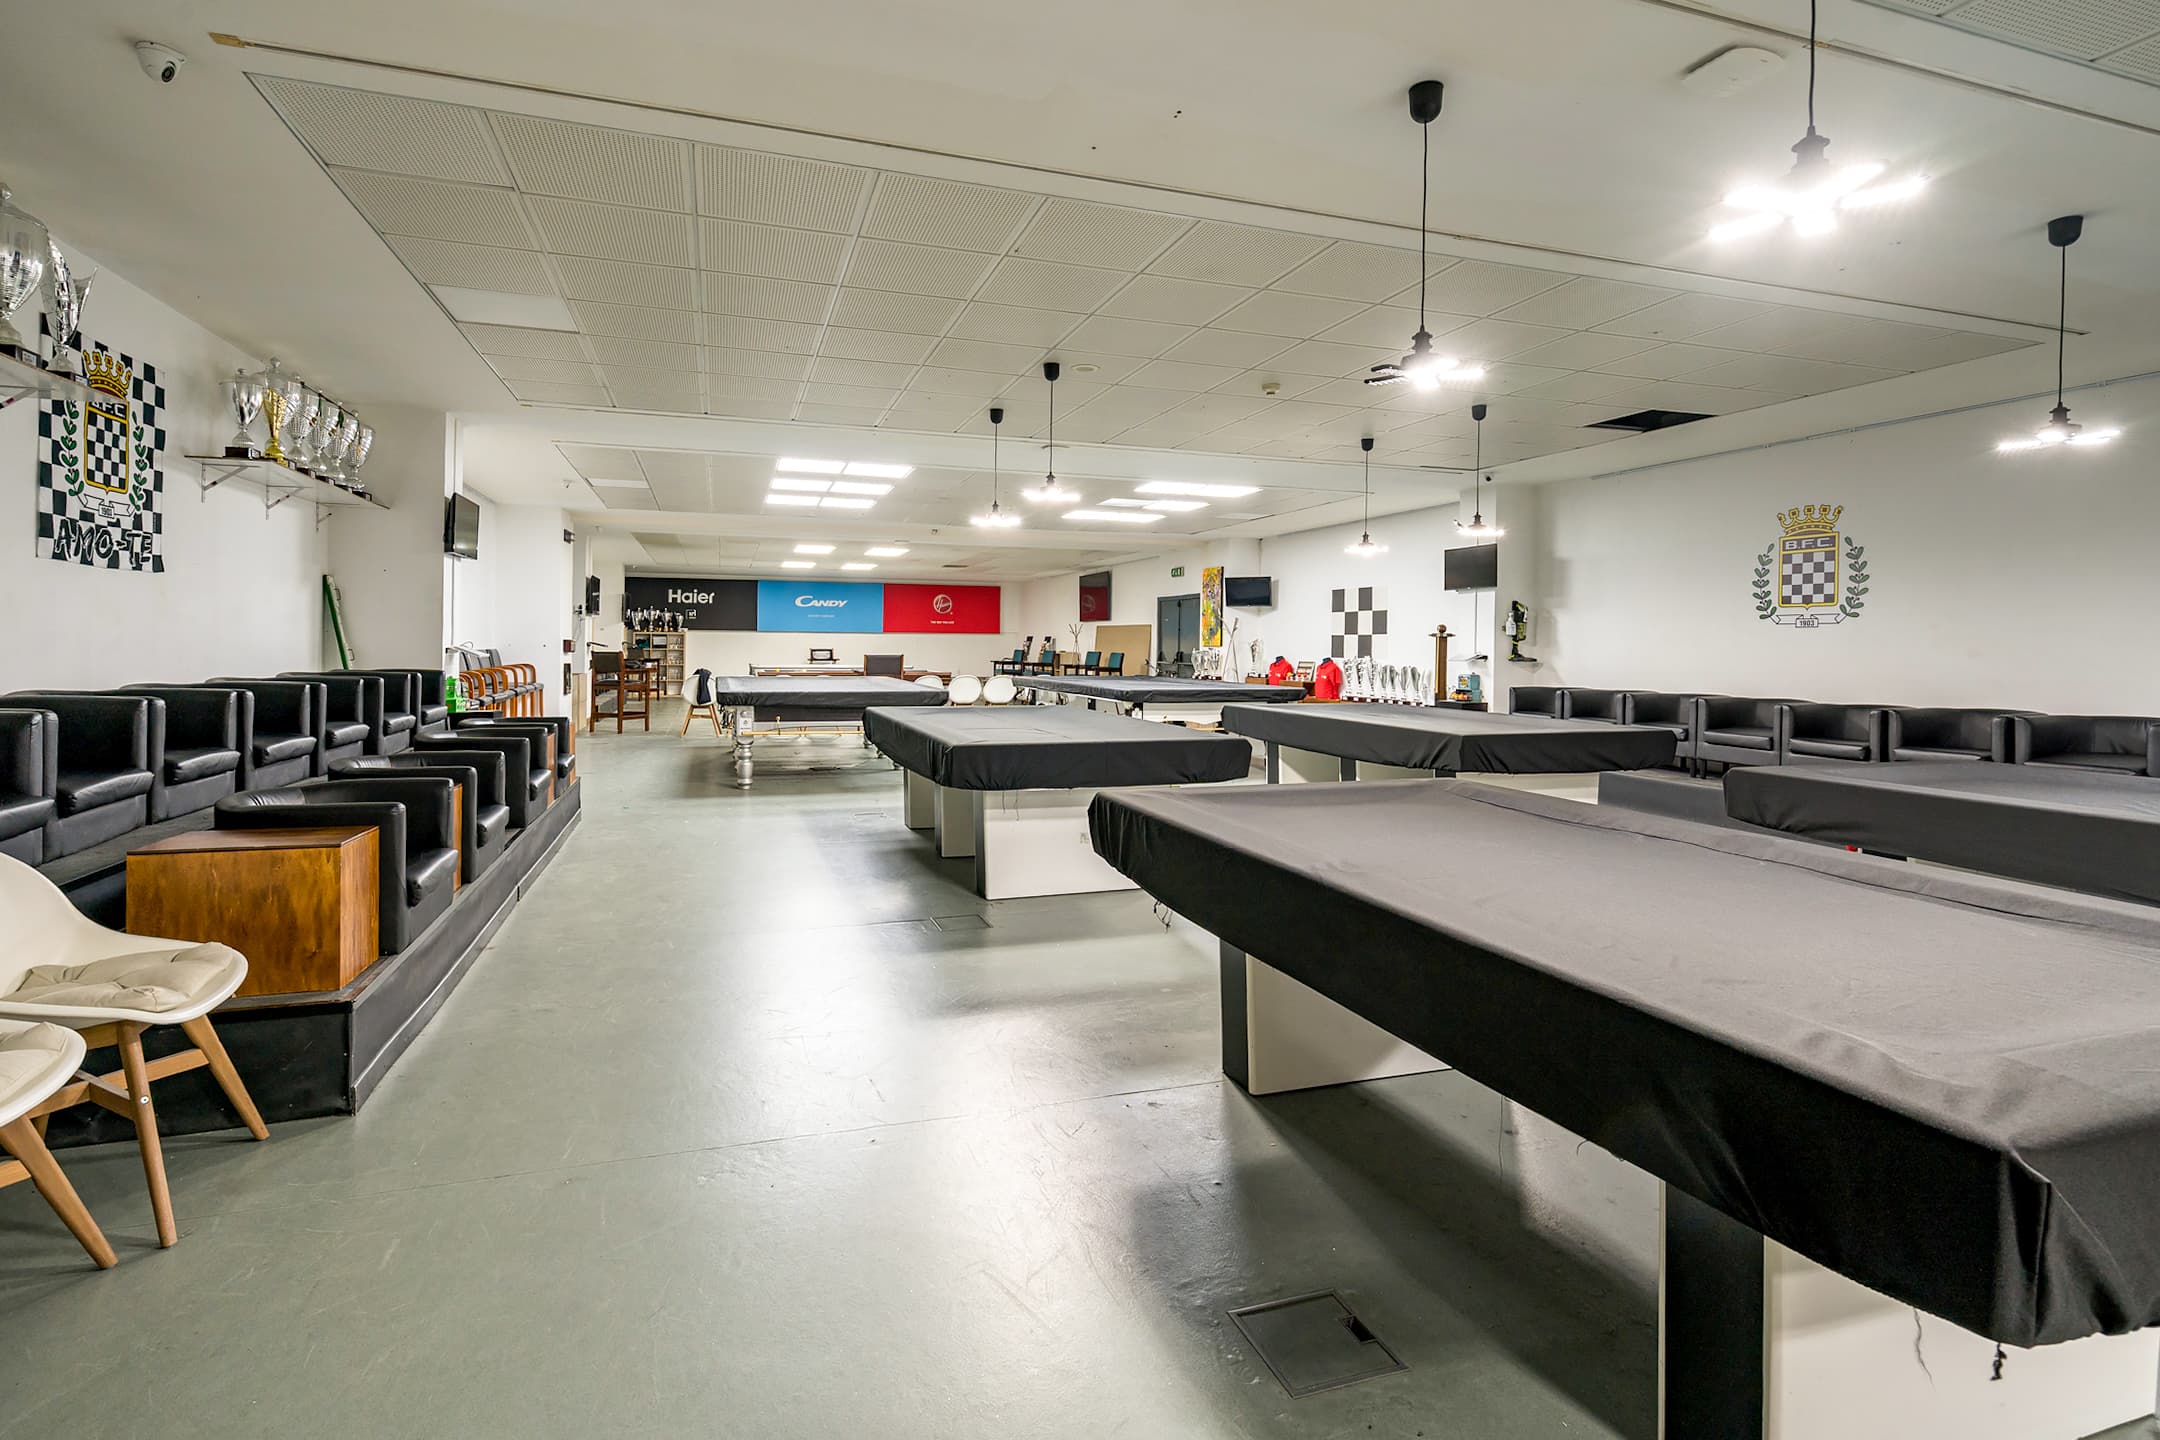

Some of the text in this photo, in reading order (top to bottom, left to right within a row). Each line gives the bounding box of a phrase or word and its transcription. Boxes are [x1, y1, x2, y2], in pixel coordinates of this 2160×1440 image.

[54, 518, 153, 567] AMO-TE
[1785, 537, 1833, 550] B.F.C.
[668, 589, 715, 604] Haier
[795, 595, 848, 607] CANDY
